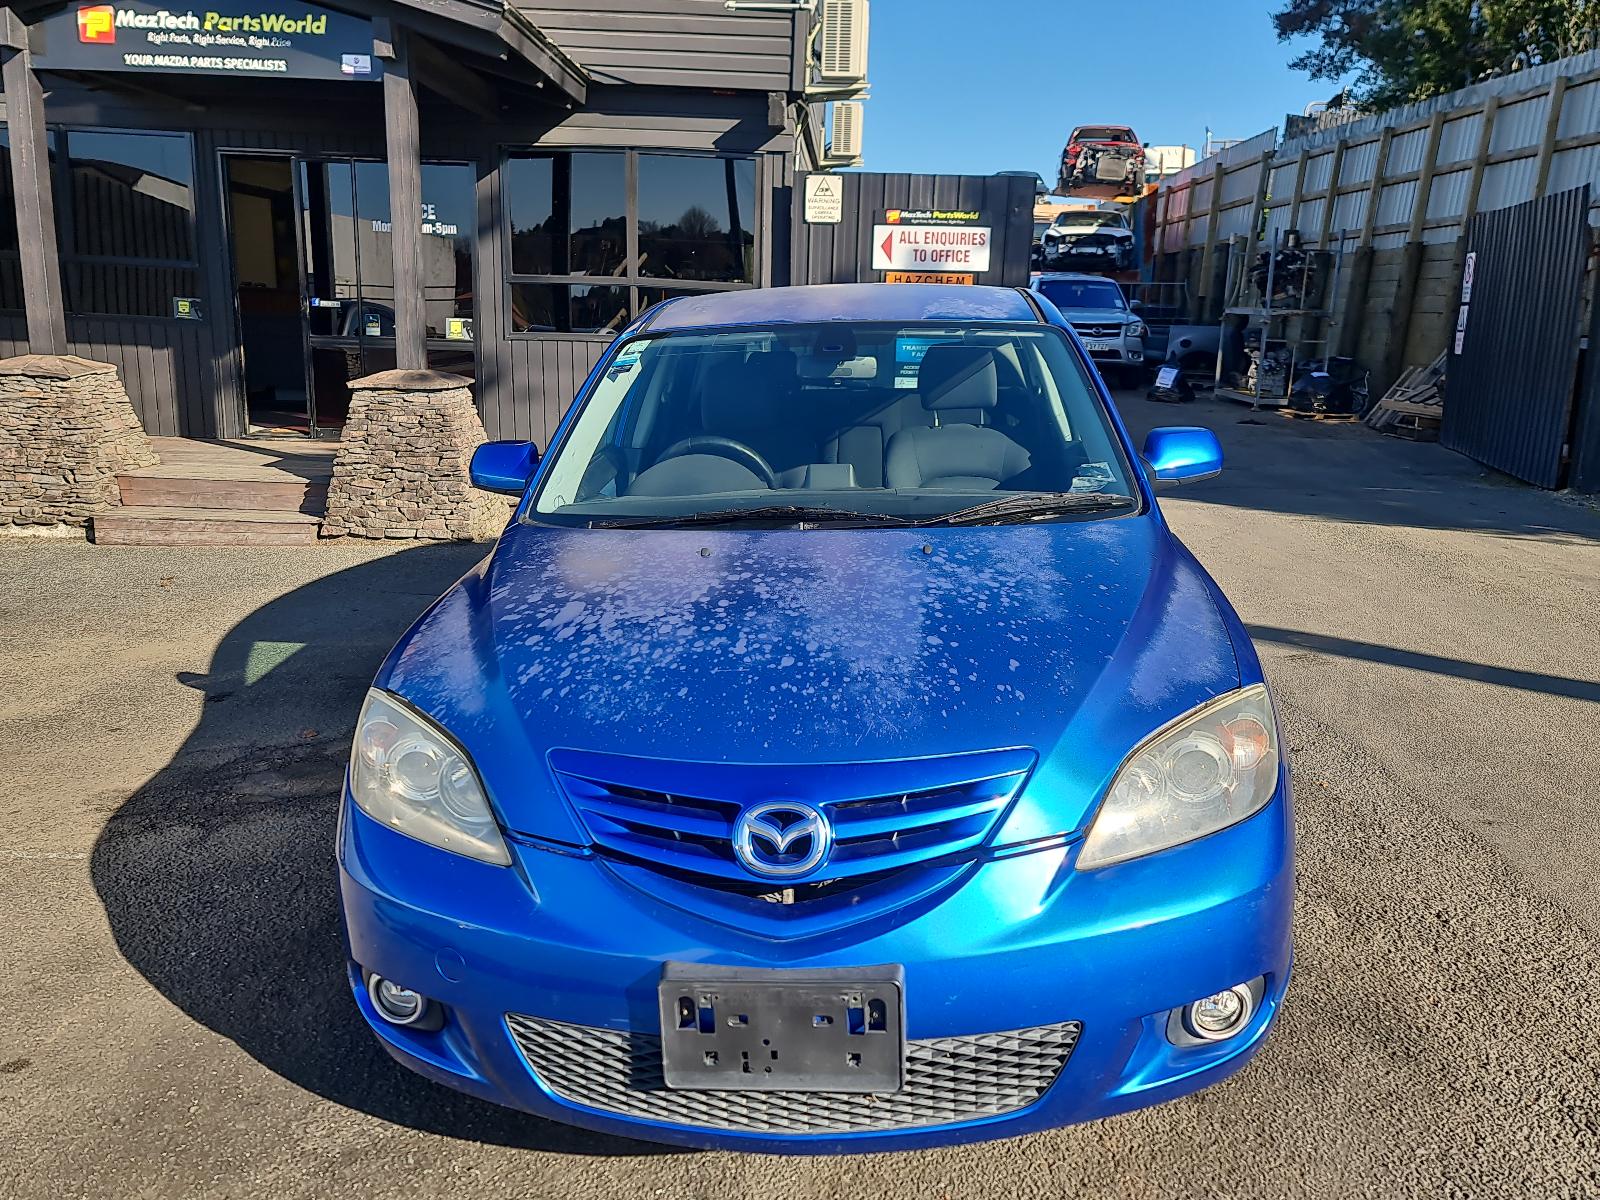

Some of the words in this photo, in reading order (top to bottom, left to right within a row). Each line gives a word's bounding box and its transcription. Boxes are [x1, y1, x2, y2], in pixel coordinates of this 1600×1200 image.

[115, 10, 199, 30] MazTech
[204, 12, 327, 33] PartsWorld
[124, 54, 153, 65] YOUR
[153, 55, 189, 67] MAZDA
[190, 57, 223, 69] PARTS
[223, 58, 287, 72] SPECIALISTS
[932, 211, 979, 220] PartsWorld
[900, 231, 919, 244] ALL
[924, 232, 986, 246] ENQUIRIES
[913, 249, 926, 262] TO
[931, 249, 970, 262] OFFICE
